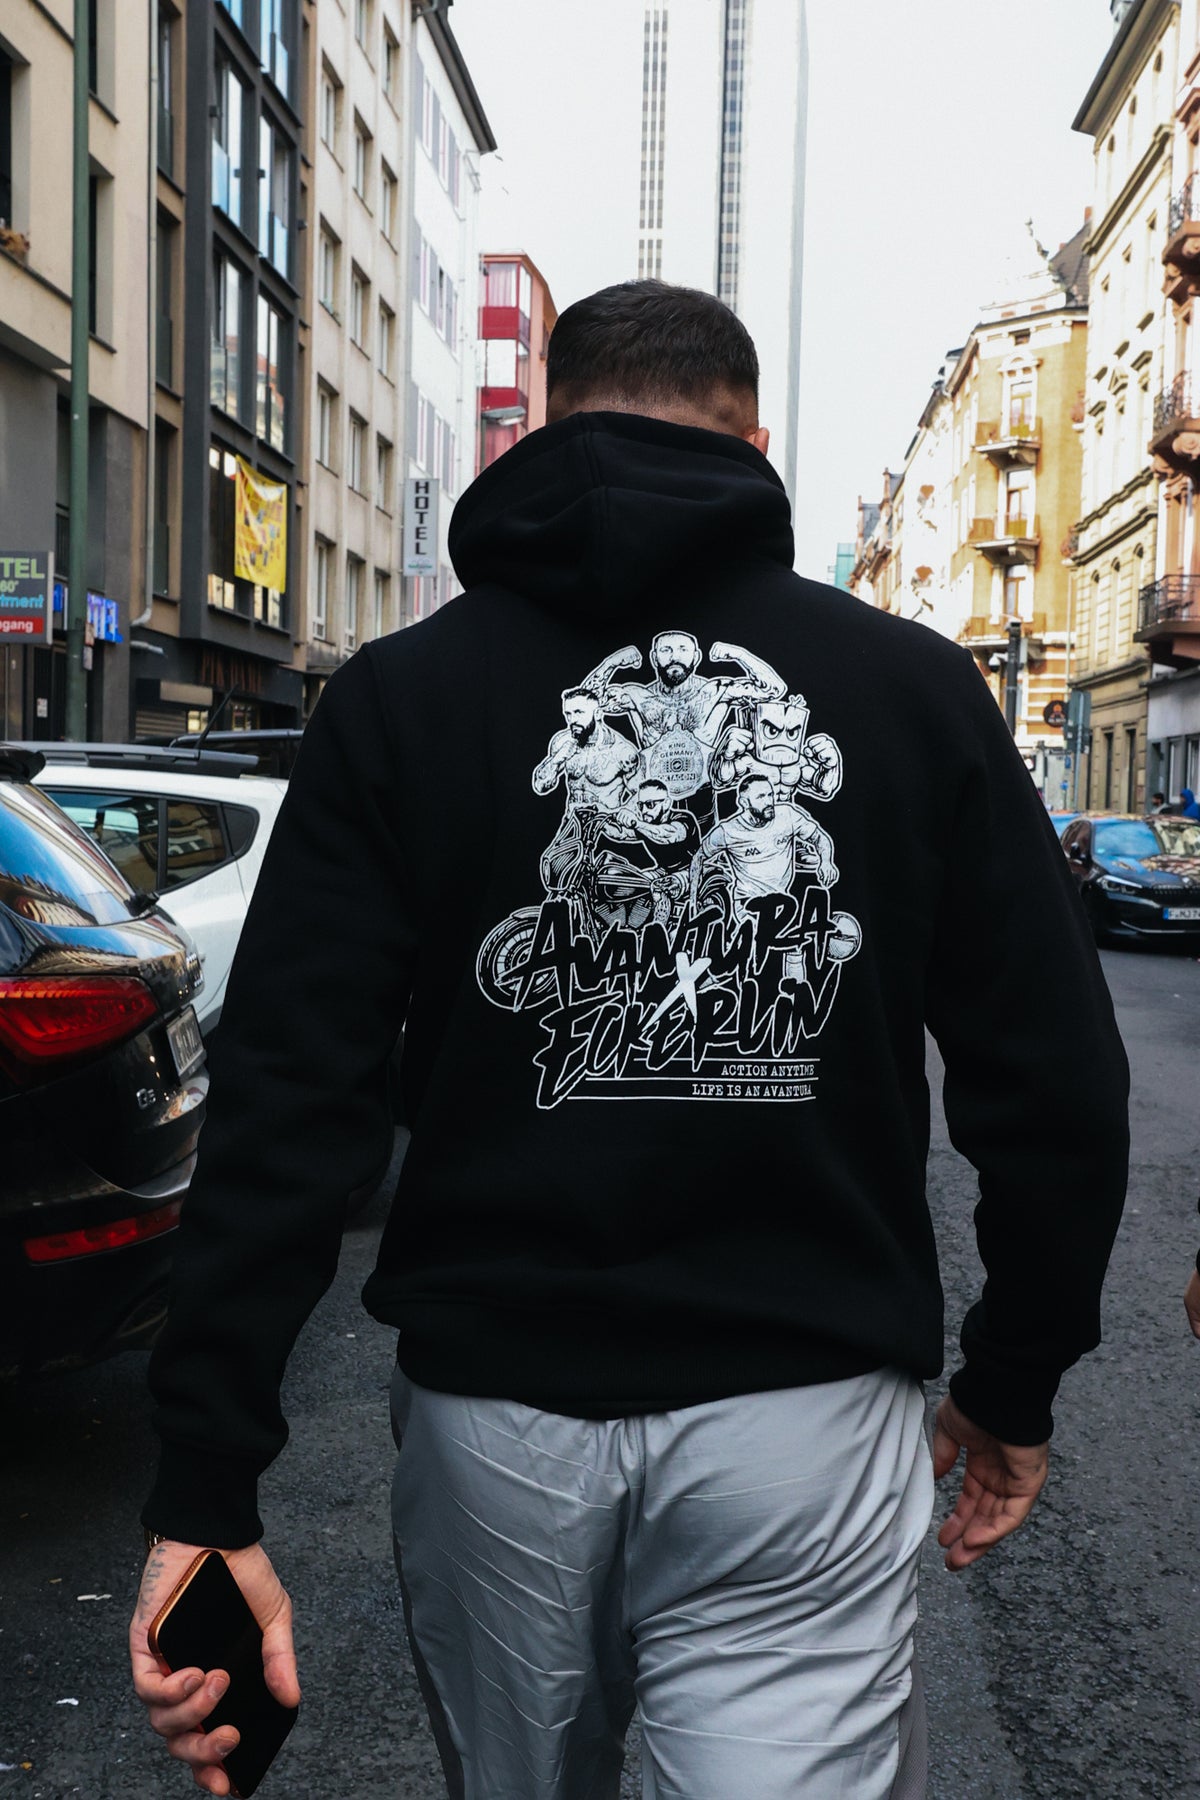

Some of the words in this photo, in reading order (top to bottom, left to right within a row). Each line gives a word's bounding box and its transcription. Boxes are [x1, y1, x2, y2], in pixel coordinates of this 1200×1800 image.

[415, 481, 429, 555] HOTEL
[660, 750, 694, 758] GERMANY
[721, 1064, 768, 1077] ACTION
[770, 1064, 815, 1077] ANYTIME
[692, 1083, 724, 1096] LIFE
[726, 1084, 742, 1096] IS
[745, 1085, 761, 1097] AN
[763, 1084, 812, 1097] AVANTURA
